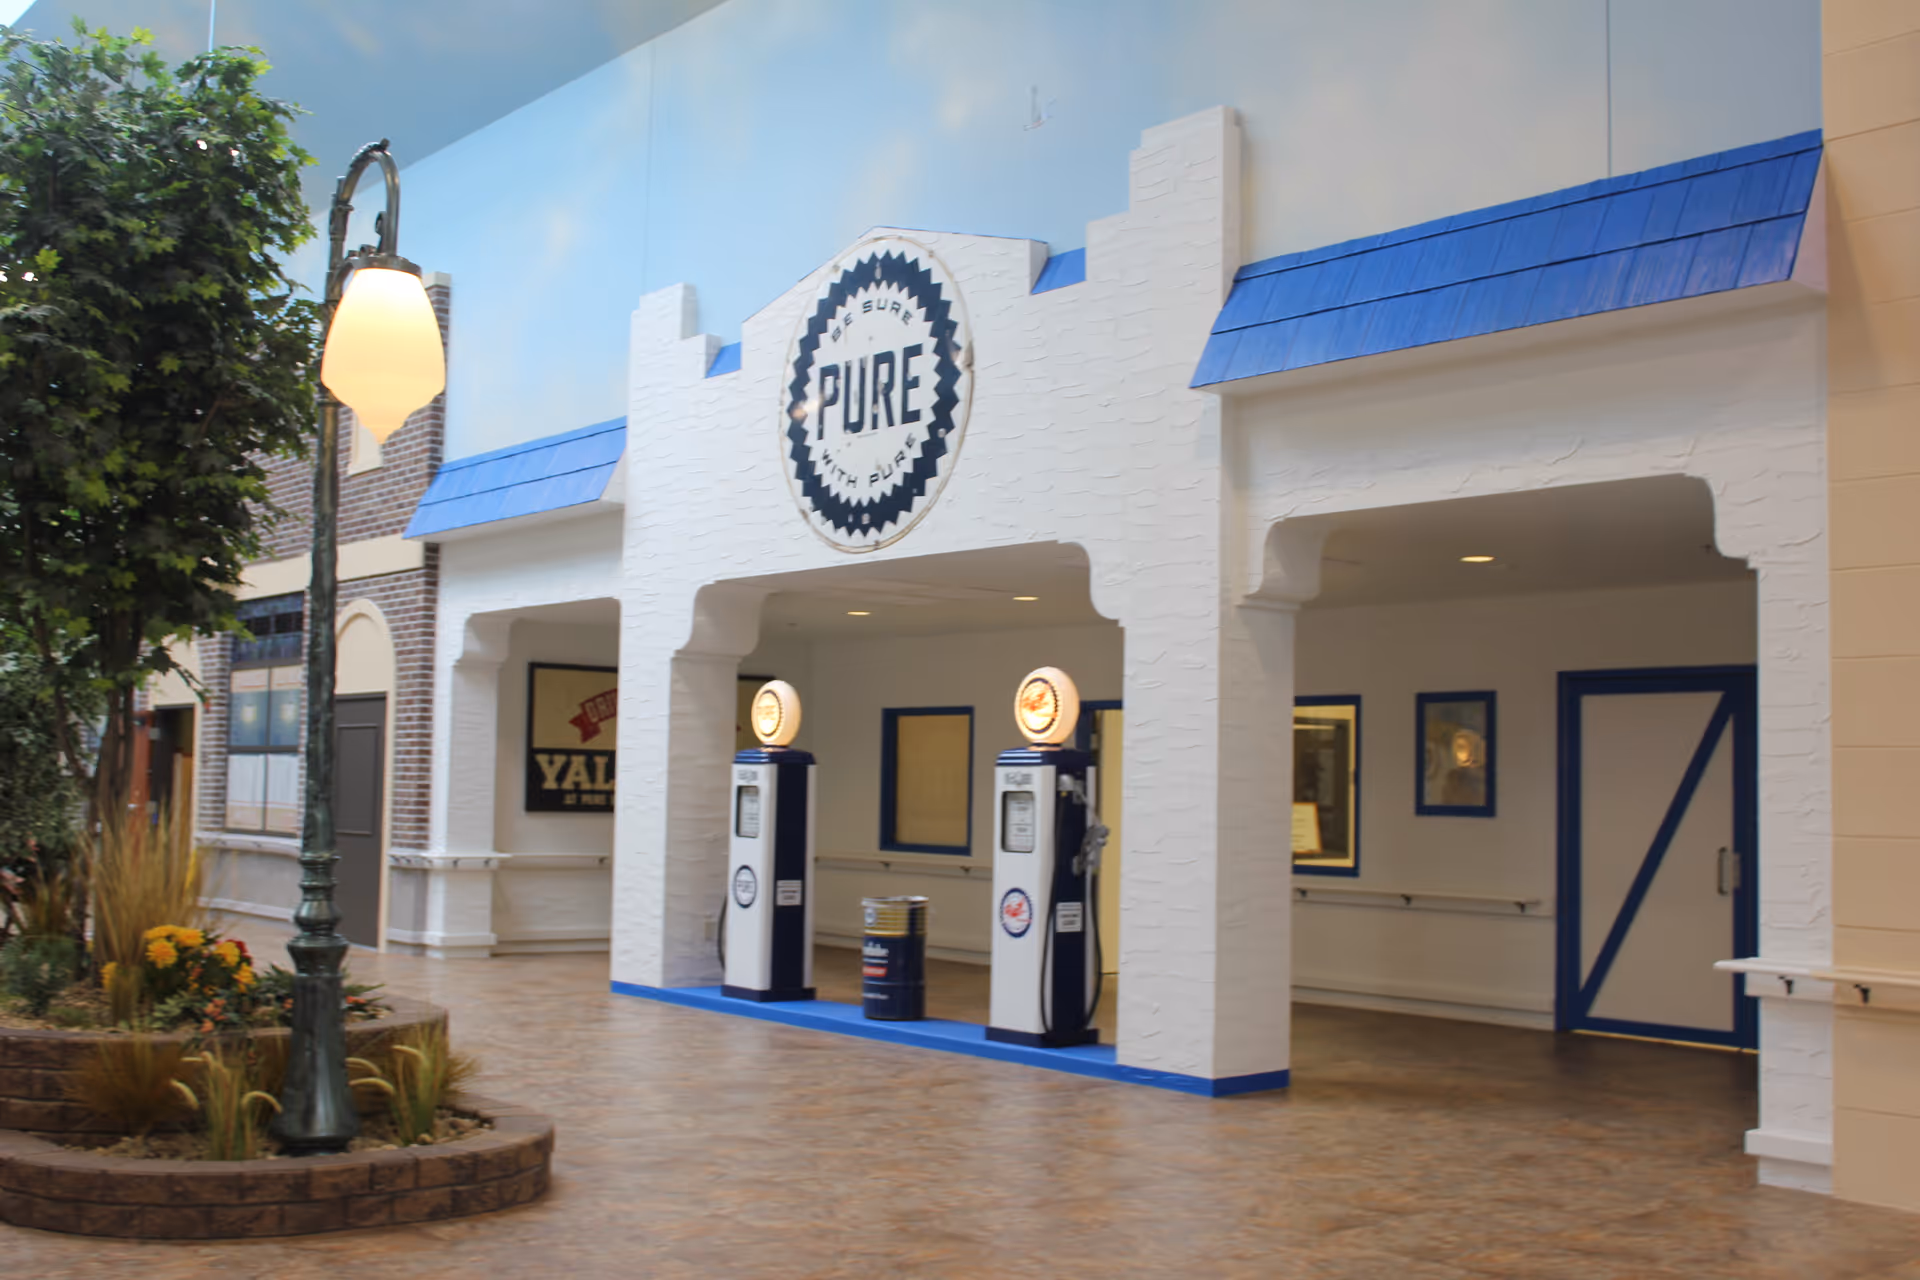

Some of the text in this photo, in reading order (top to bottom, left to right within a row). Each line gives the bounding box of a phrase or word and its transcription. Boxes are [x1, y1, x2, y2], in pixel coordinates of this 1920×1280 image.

[831, 298, 913, 342] BE SURE
[816, 343, 923, 440] PURE
[821, 432, 917, 488] WITH PURE
